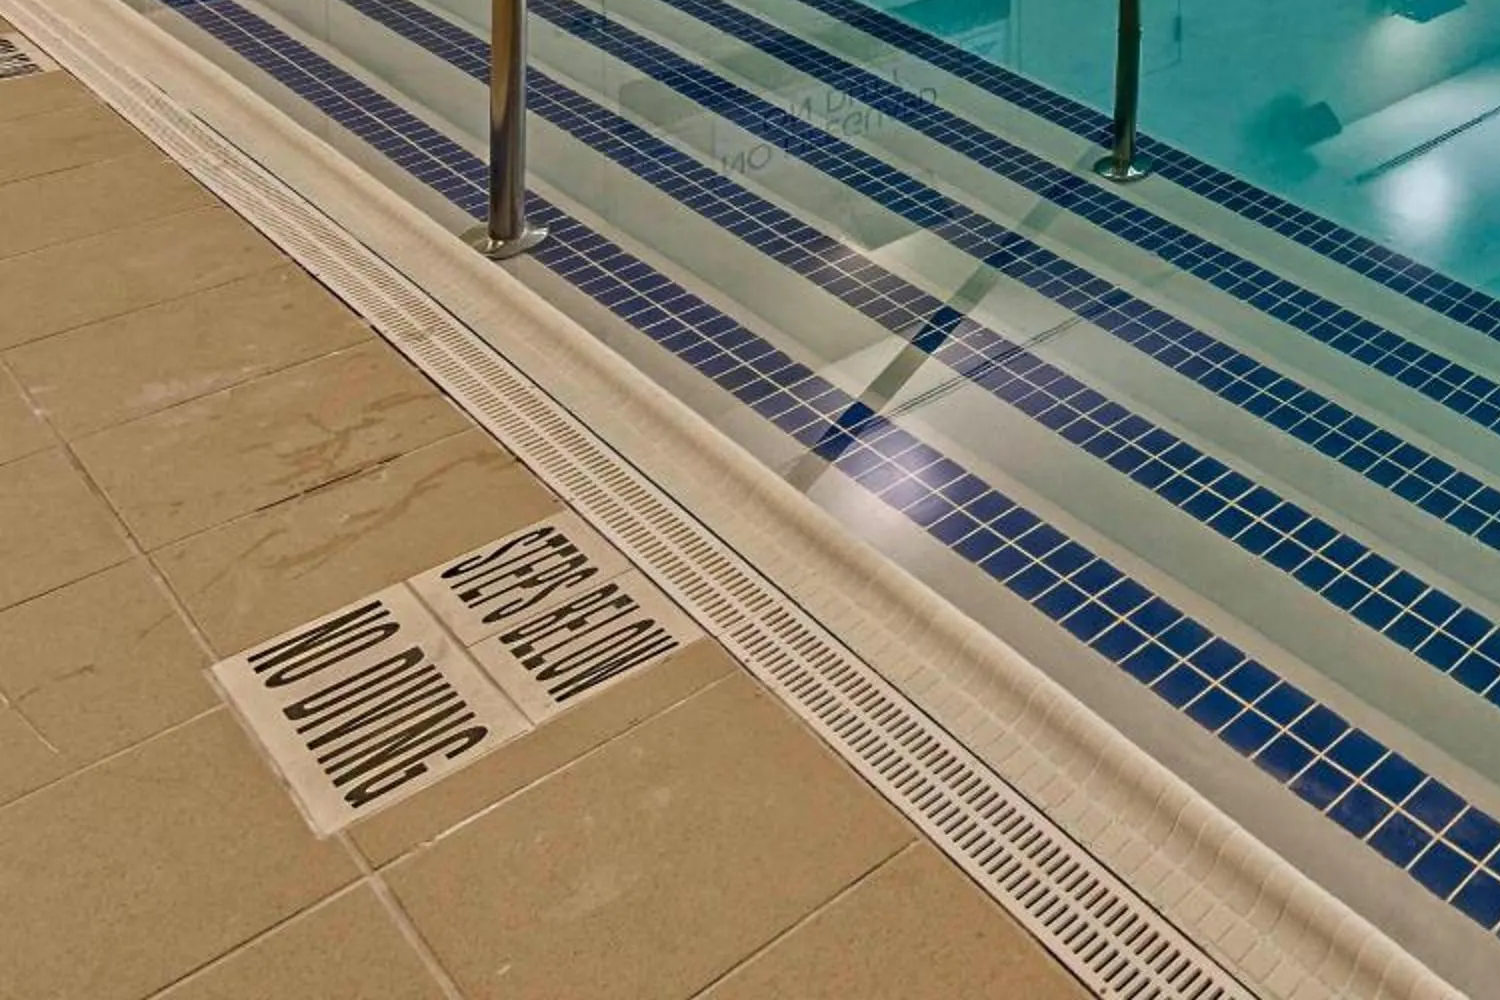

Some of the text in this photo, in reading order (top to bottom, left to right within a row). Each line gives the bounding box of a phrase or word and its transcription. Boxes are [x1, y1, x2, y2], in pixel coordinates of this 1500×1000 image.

[440, 526, 600, 624] STEPS
[247, 599, 401, 688] NO
[499, 582, 680, 703] BELOW
[282, 645, 490, 809] DIVING
